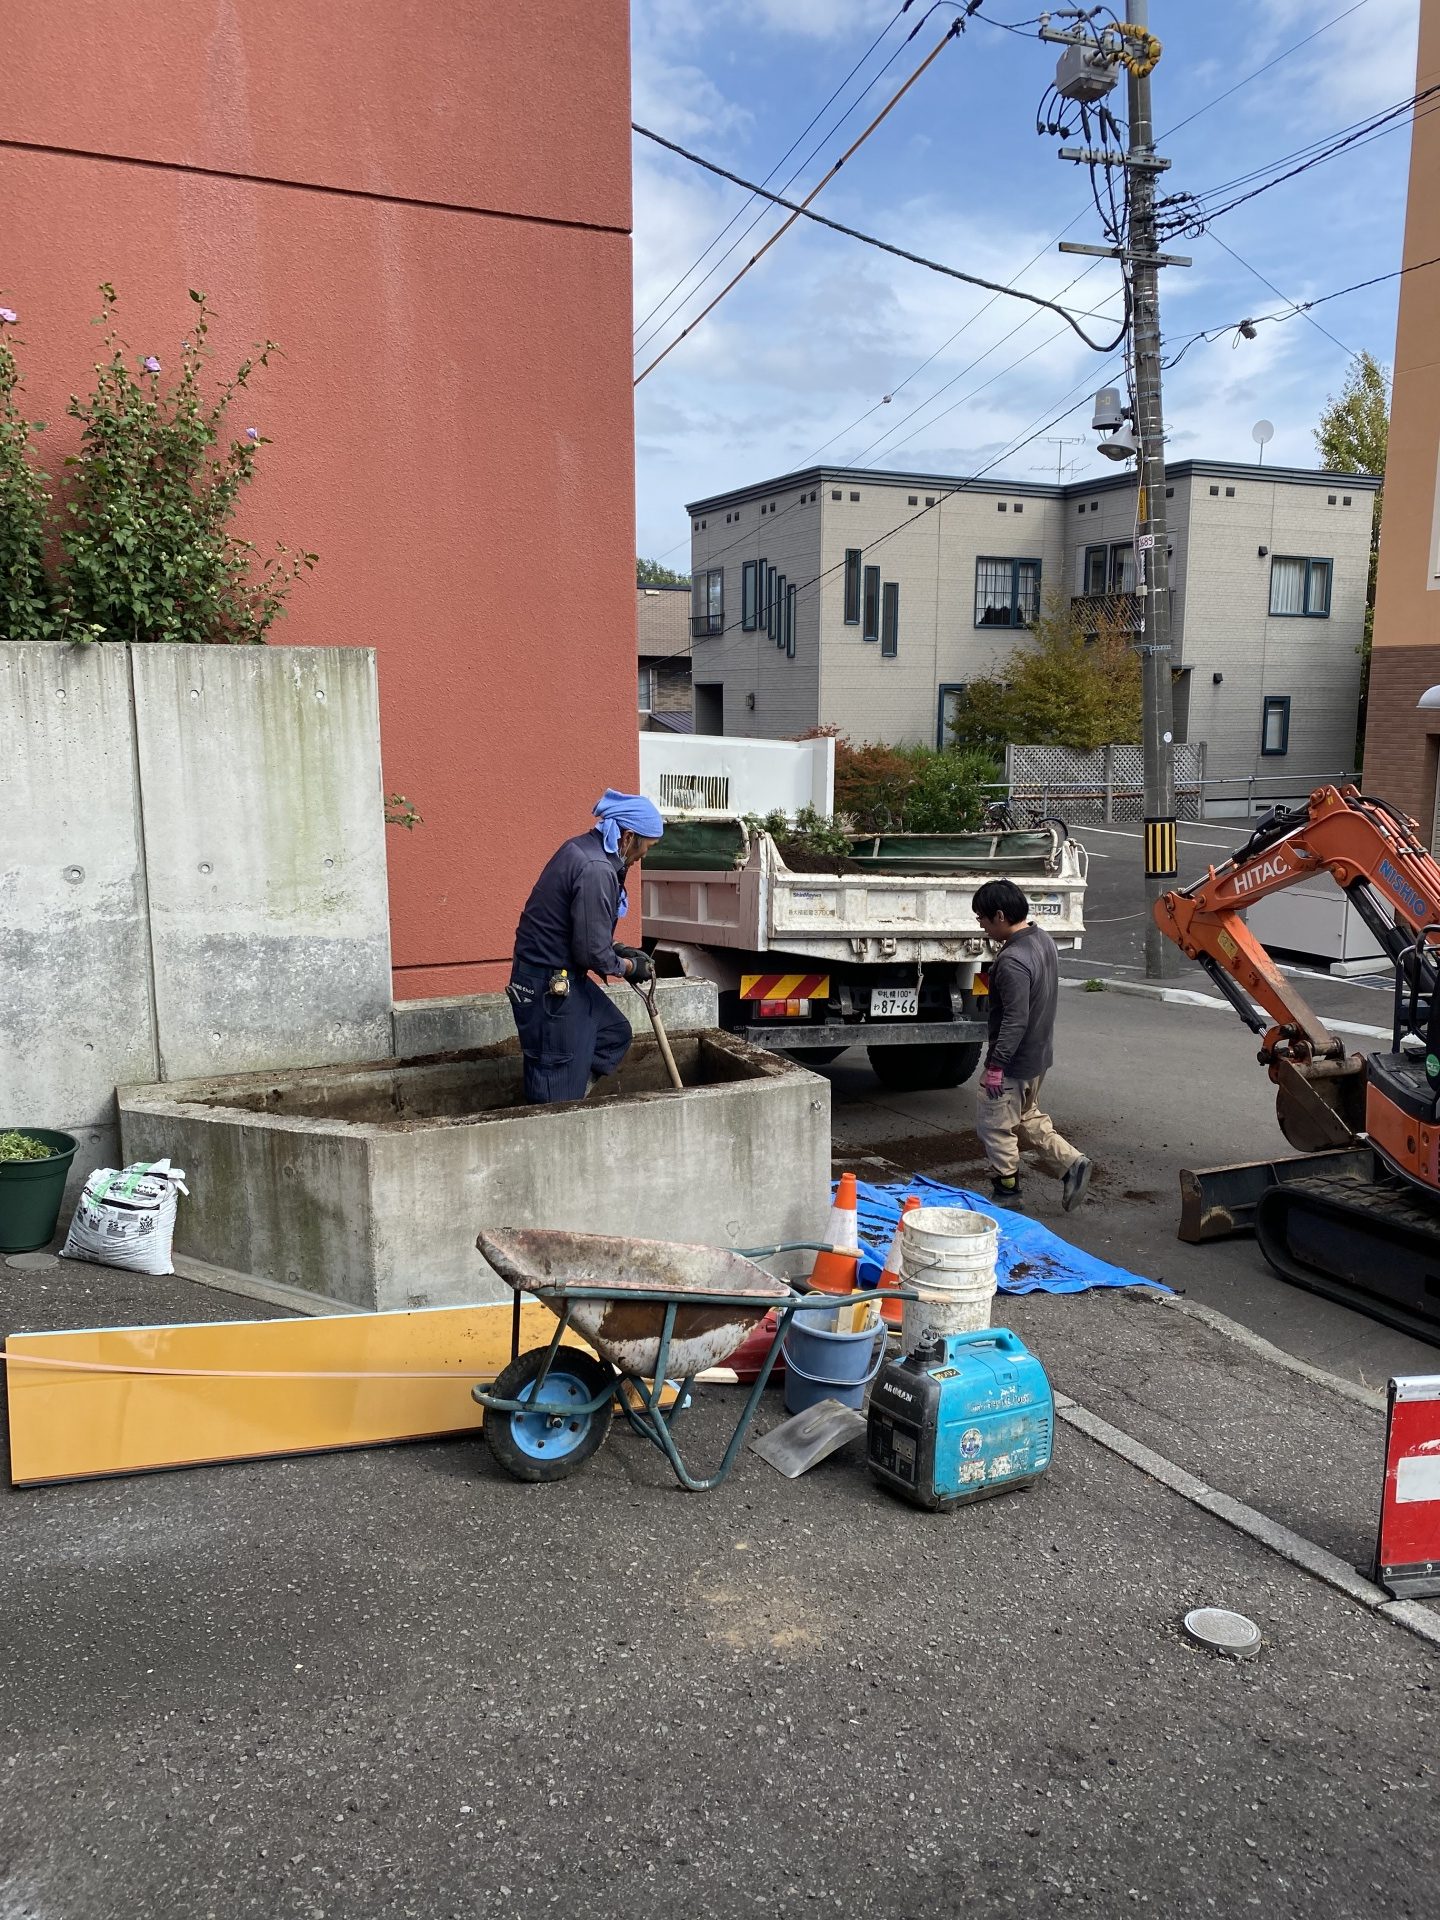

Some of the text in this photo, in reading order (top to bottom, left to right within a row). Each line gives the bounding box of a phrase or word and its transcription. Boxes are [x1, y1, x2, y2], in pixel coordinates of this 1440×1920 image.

[1233, 855, 1291, 894] HITAC
[1378, 858, 1428, 917] NISHIO
[1028, 905, 1059, 914] SUZU
[881, 1000, 915, 1014] 87-66
